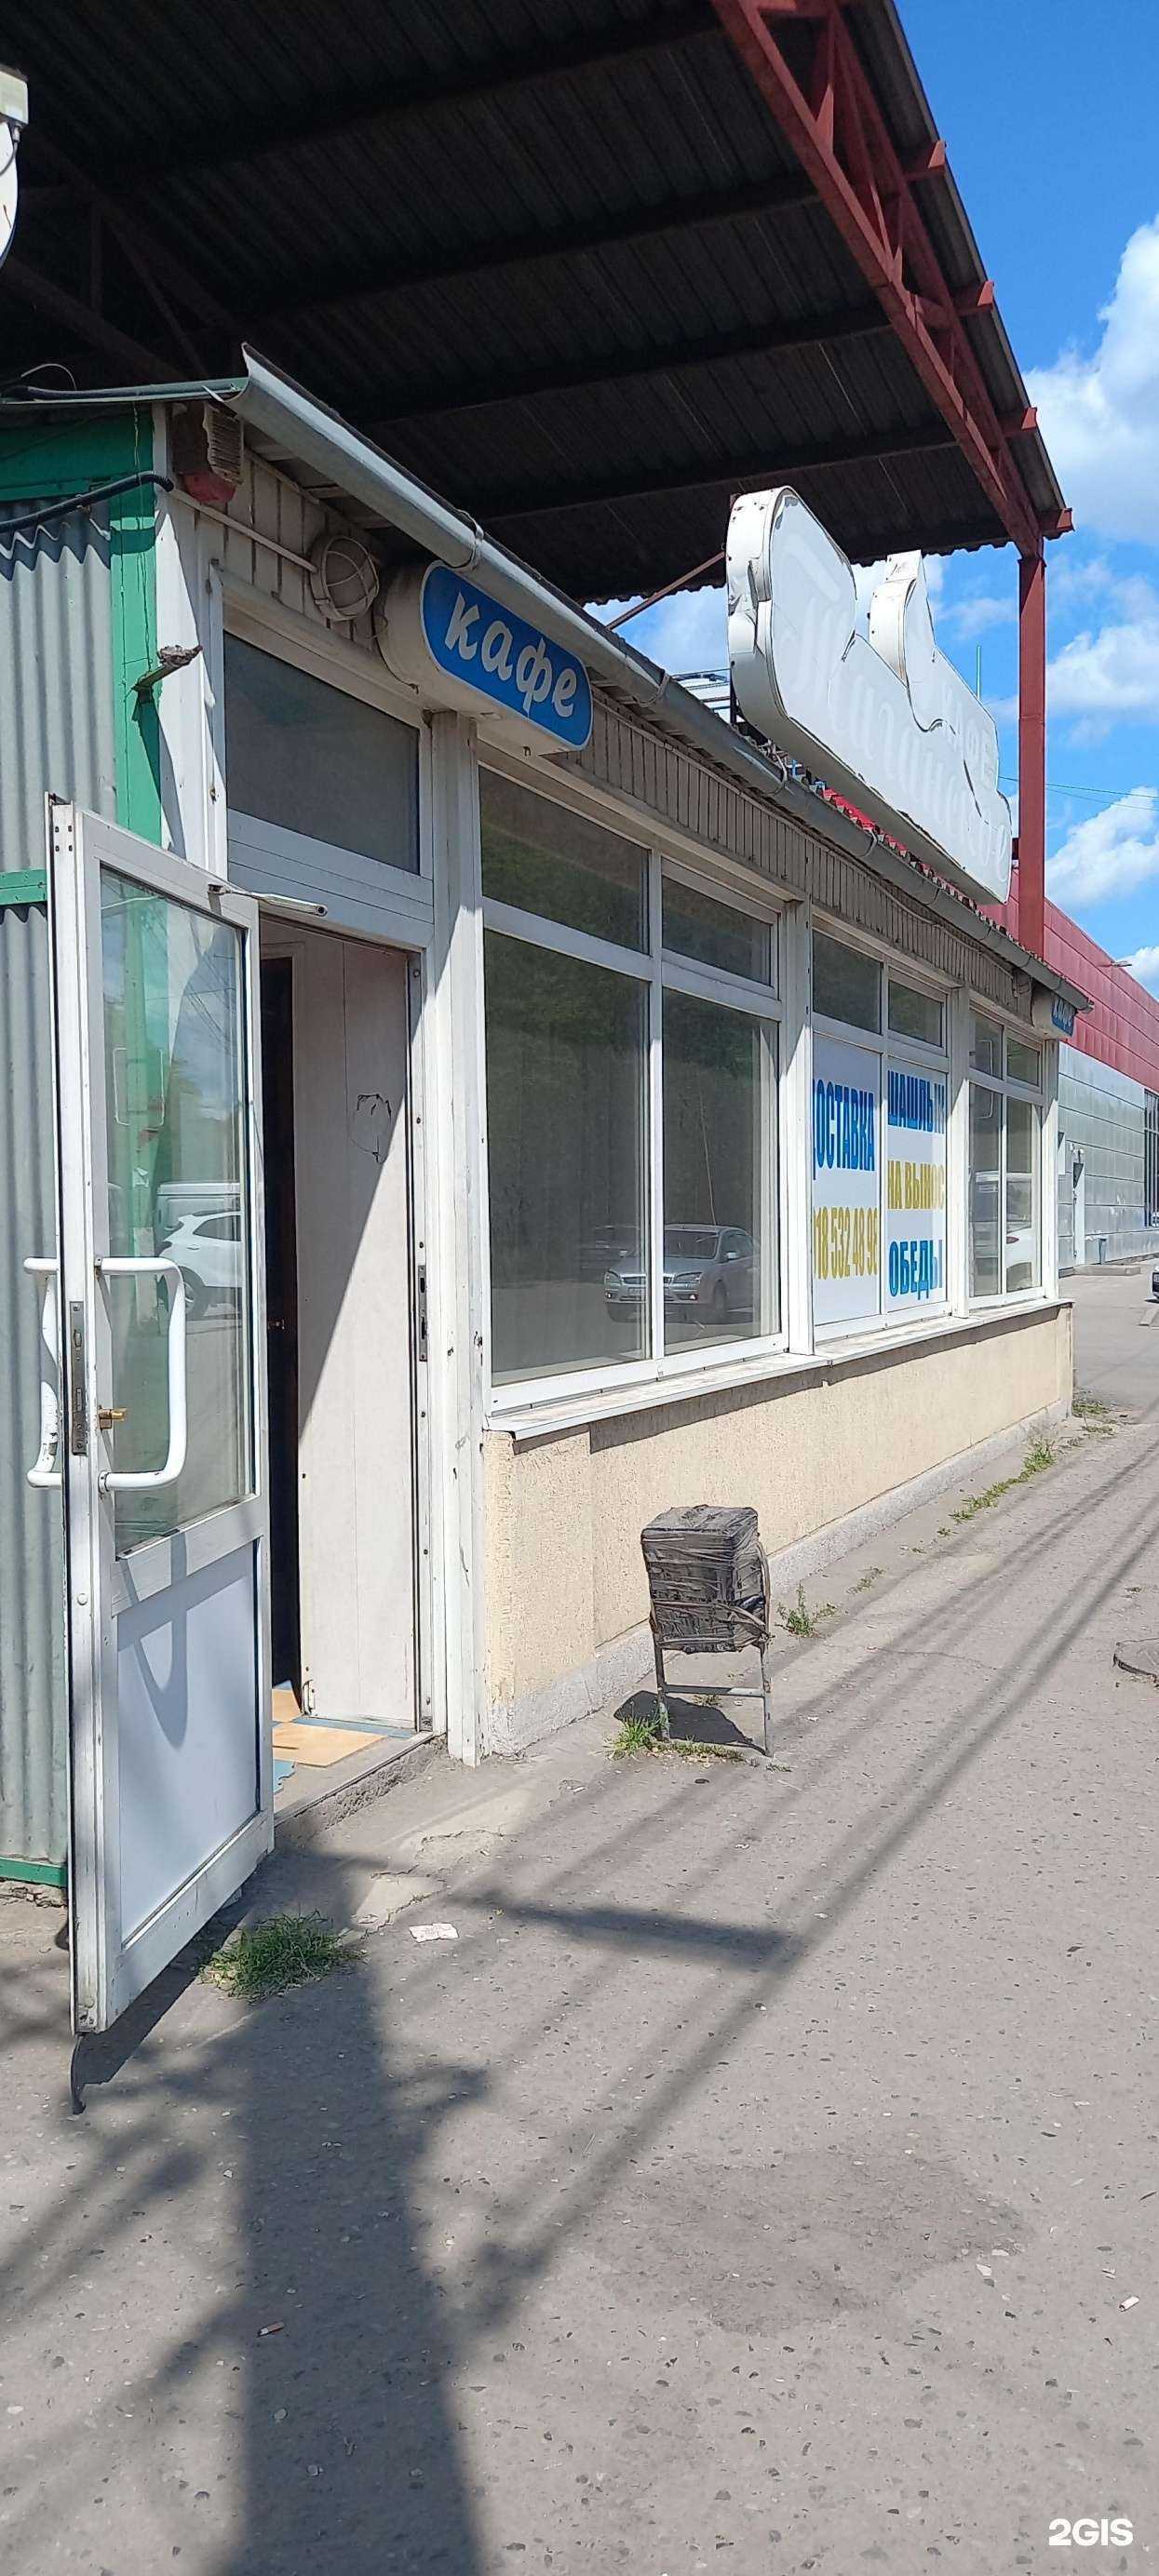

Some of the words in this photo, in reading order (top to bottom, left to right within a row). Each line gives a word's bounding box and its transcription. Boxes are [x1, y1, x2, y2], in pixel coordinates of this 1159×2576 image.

[444, 592, 577, 718] кафе
[887, 1069, 945, 1134] ШАШЛЫК
[887, 1160, 902, 1210] НА
[905, 1161, 945, 1210] ВЫНОС
[830, 1206, 850, 1279] 532
[888, 1240, 943, 1300] ОБЕДЫ
